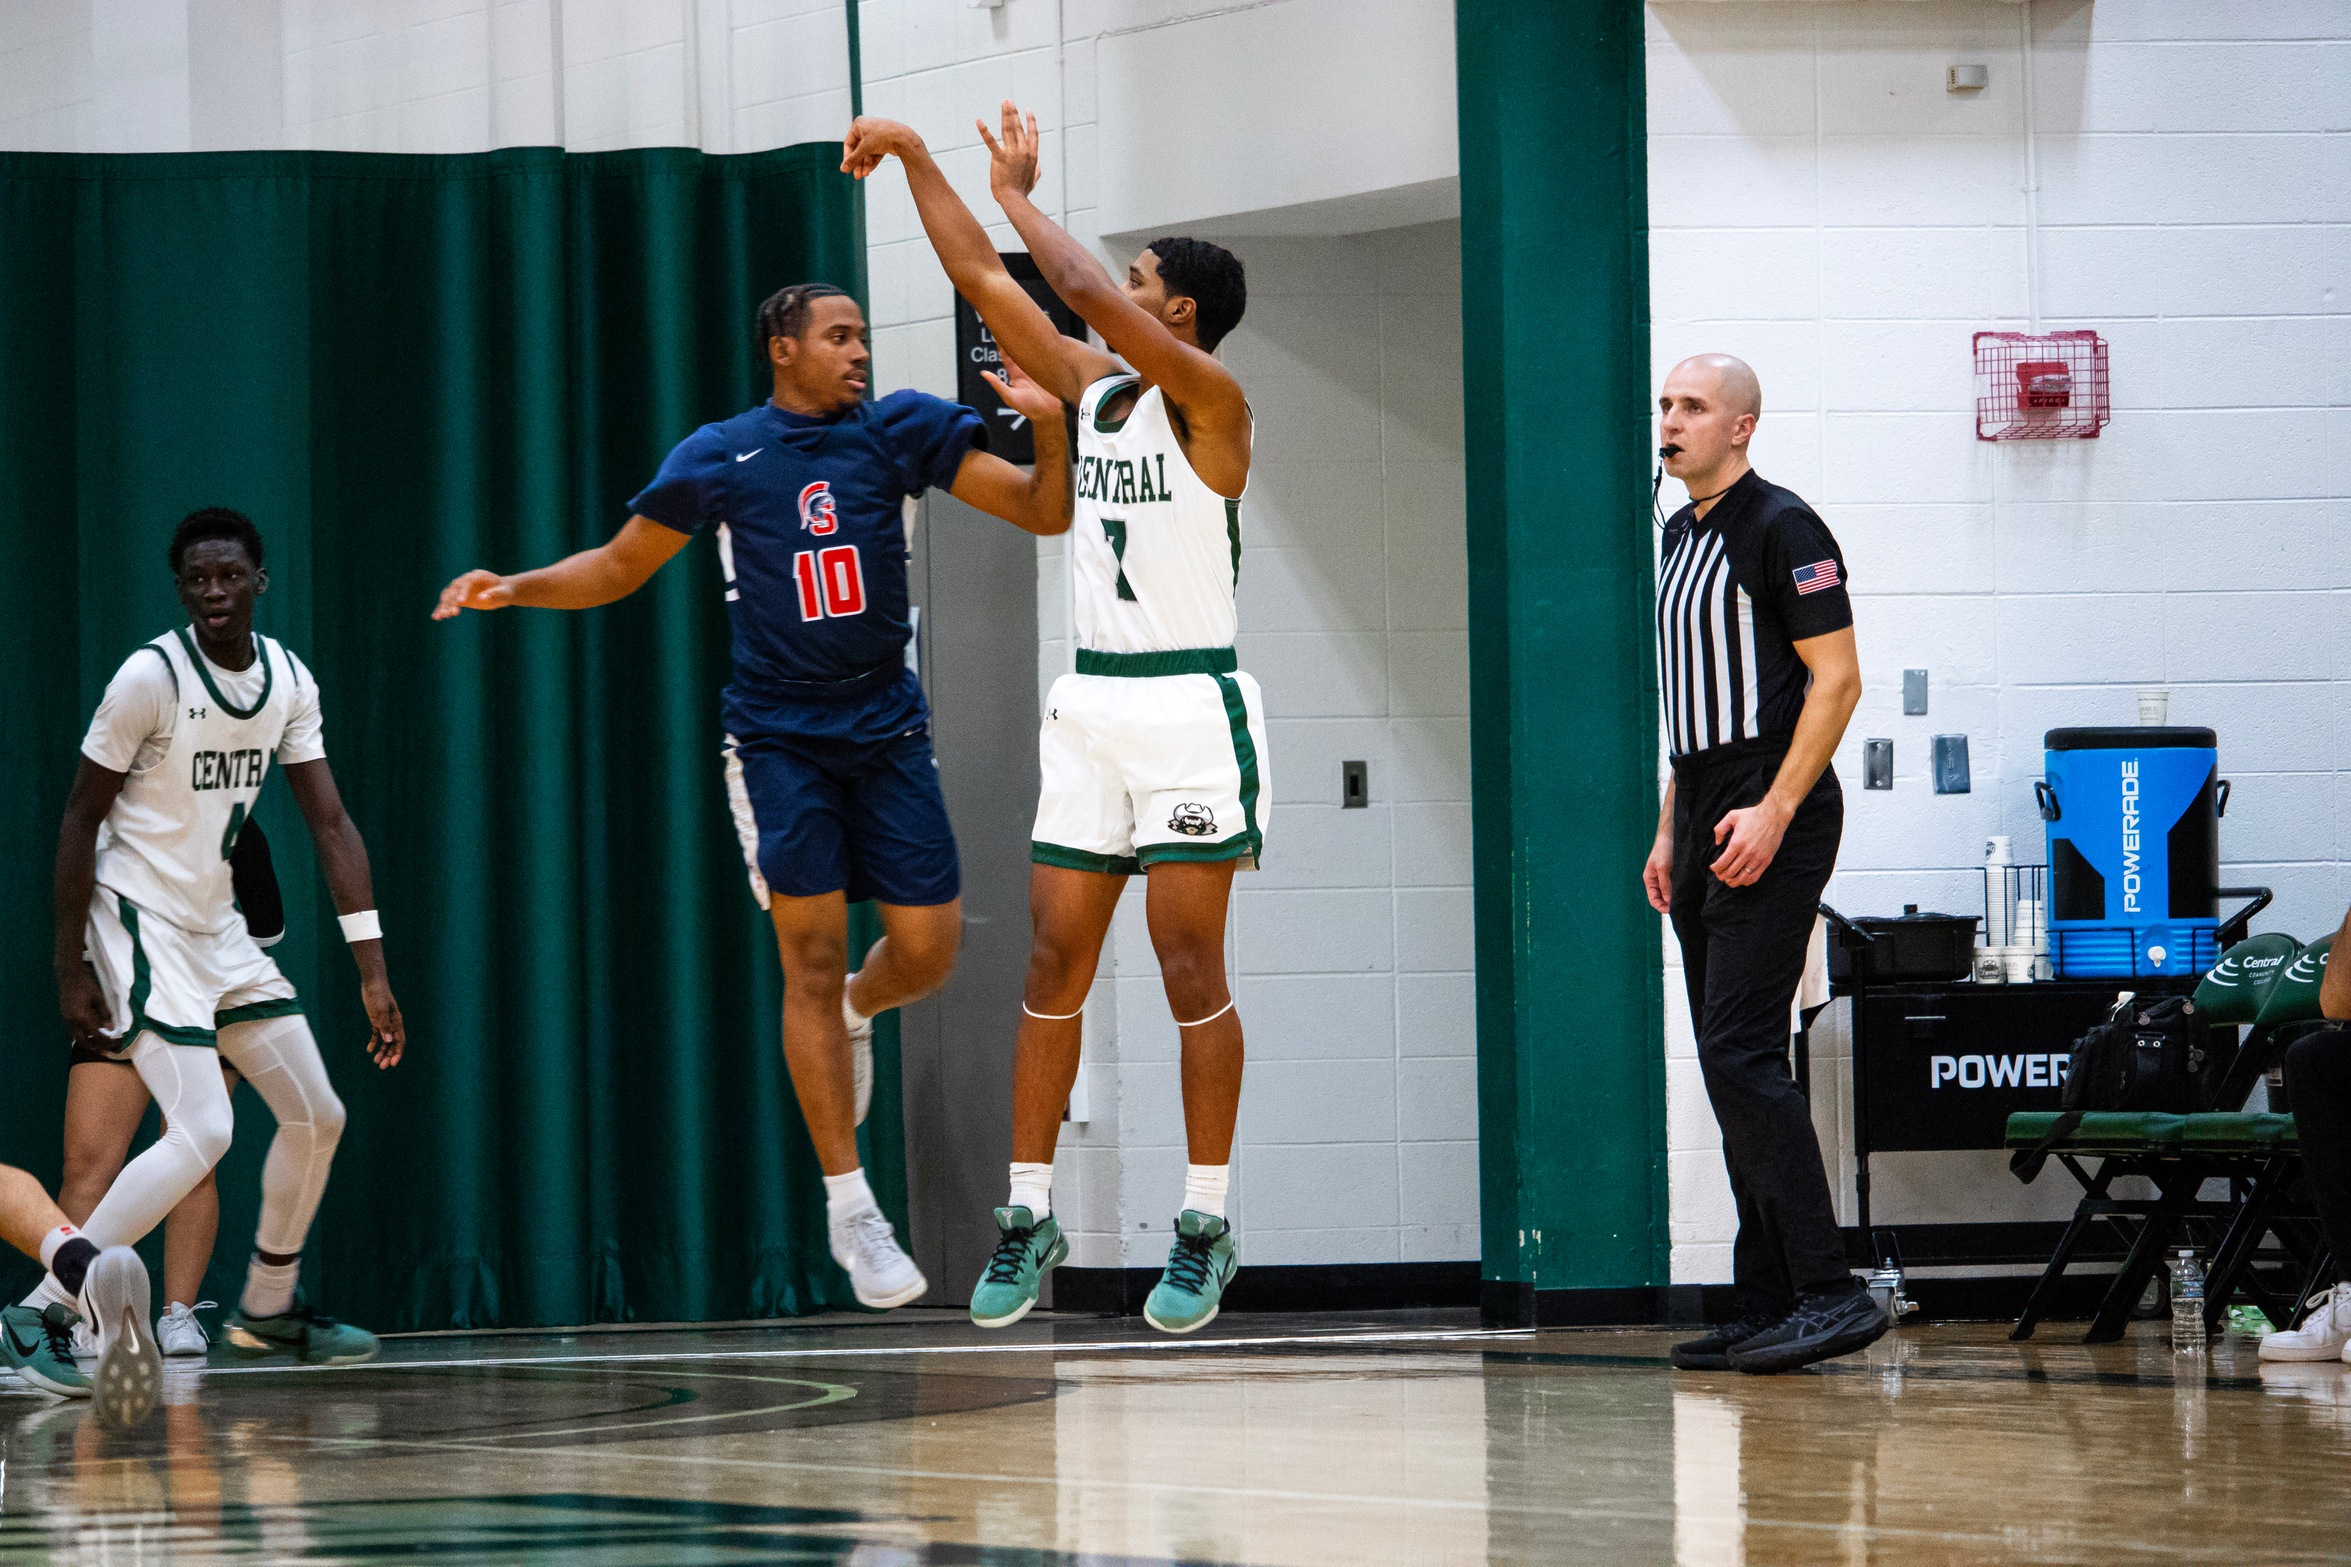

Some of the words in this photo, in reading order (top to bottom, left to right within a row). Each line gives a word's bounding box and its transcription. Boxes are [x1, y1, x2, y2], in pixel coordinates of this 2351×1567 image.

[792, 544, 867, 622] 10
[1099, 517, 1140, 604] 7
[192, 747, 279, 792] CENTR
[2121, 760, 2142, 913] POWERADE
[2242, 955, 2285, 969] Central
